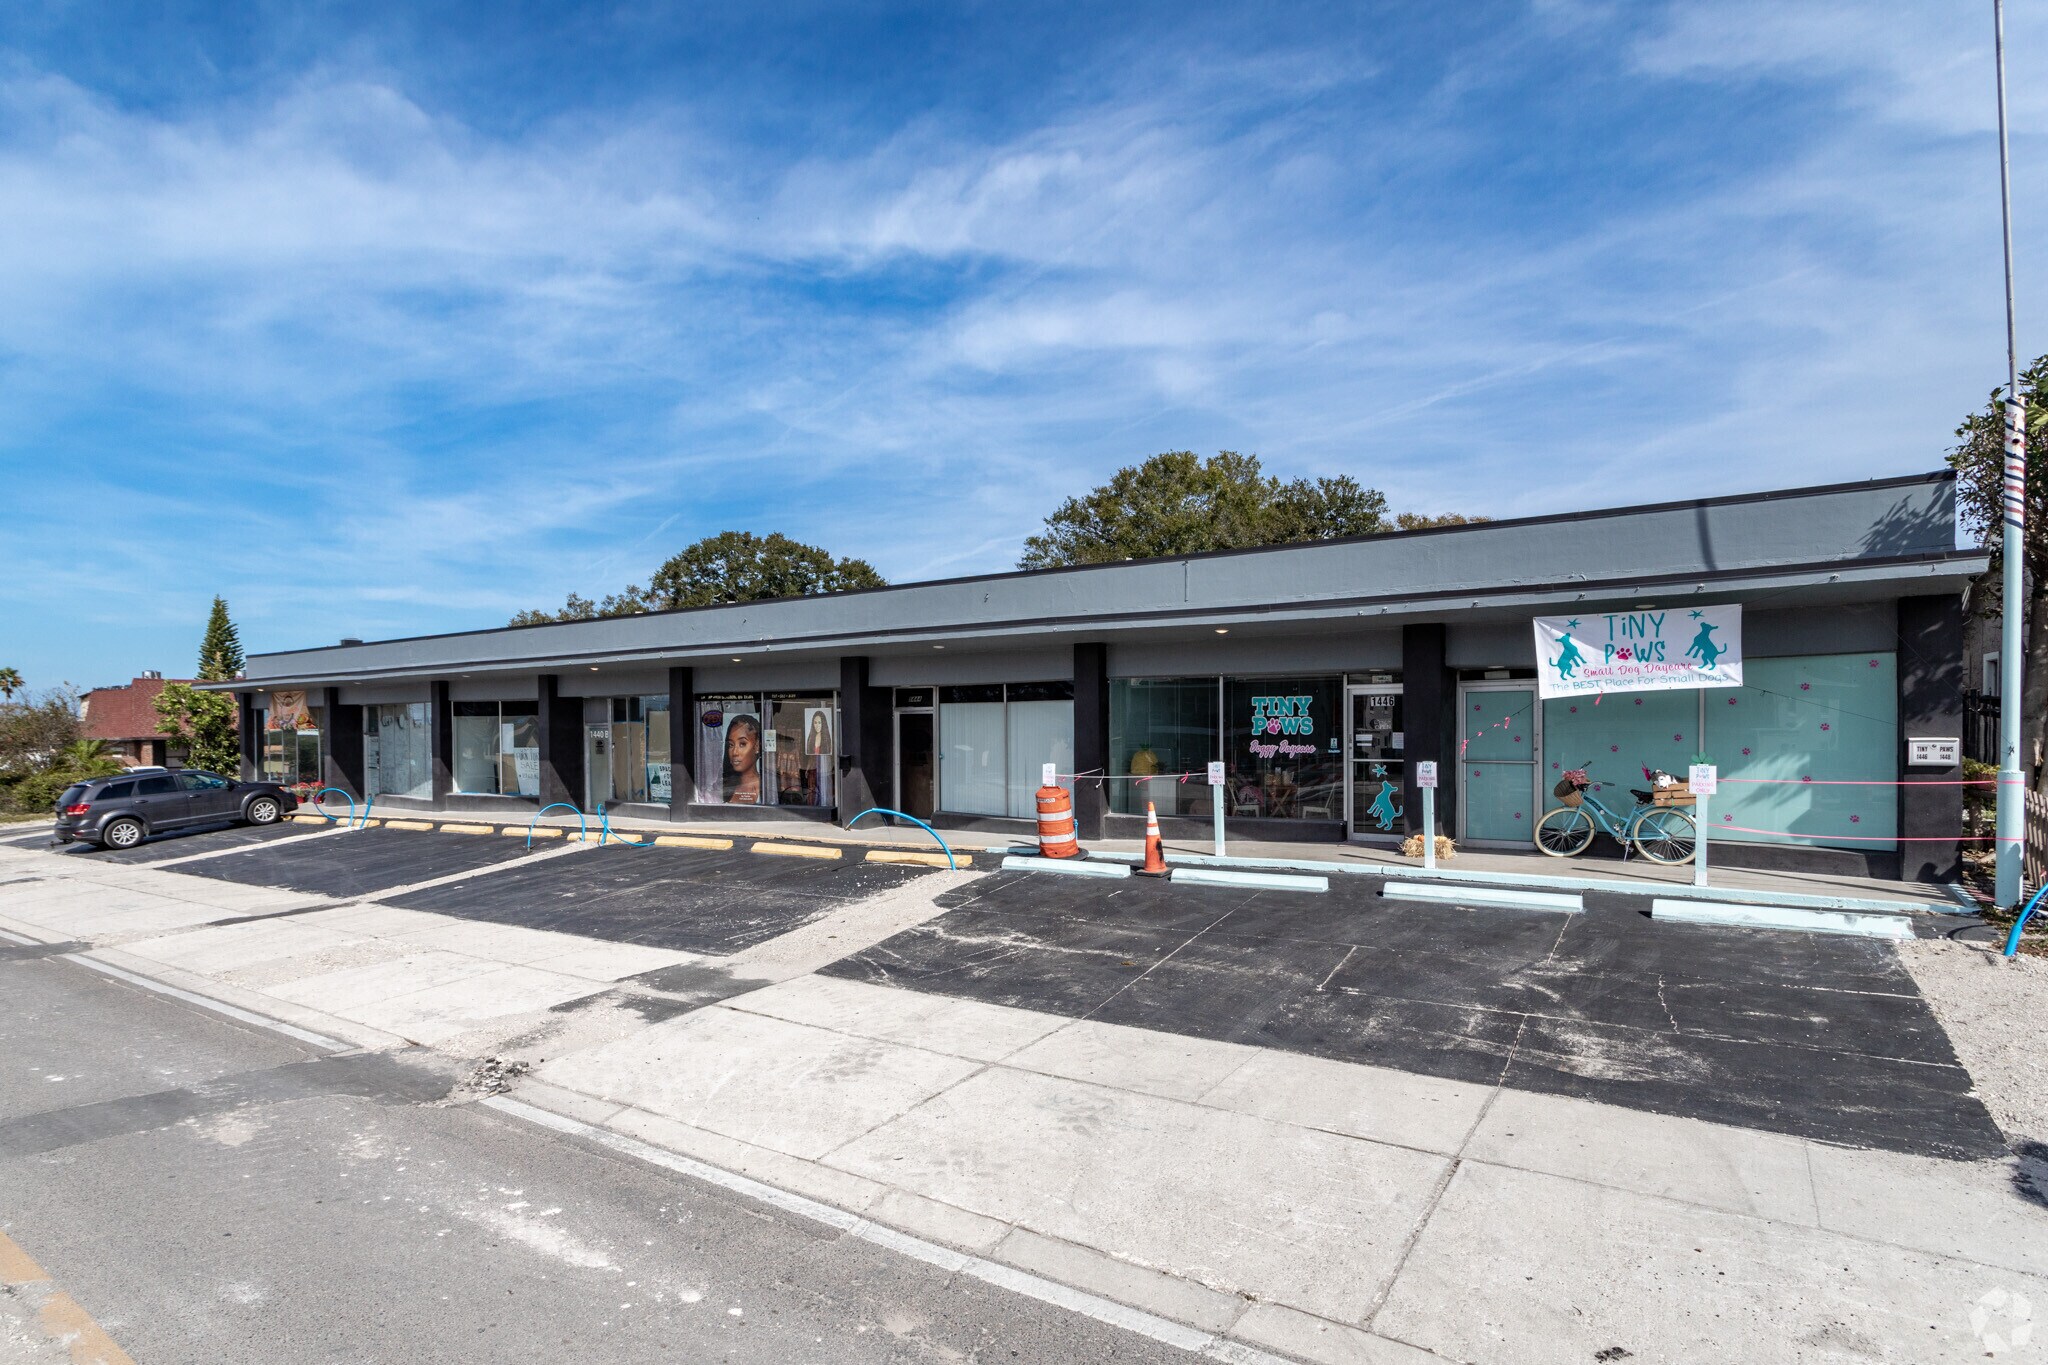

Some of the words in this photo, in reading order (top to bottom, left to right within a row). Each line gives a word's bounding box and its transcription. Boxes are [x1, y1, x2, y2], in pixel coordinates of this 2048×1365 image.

[1583, 665, 1613, 678] Small
[1617, 665, 1640, 676] Dog
[1644, 661, 1693, 674] Daycare
[1551, 683, 1570, 691] The
[1573, 680, 1601, 690] BEST
[1605, 677, 1634, 687] Place
[1637, 675, 1656, 685] For
[1659, 673, 1695, 684] Small
[1699, 672, 1729, 683] Dogs
[1252, 696, 1313, 716] TINY
[1371, 696, 1394, 706] 1446
[1249, 739, 1279, 758] Doggy
[1279, 739, 1316, 758] Daycare
